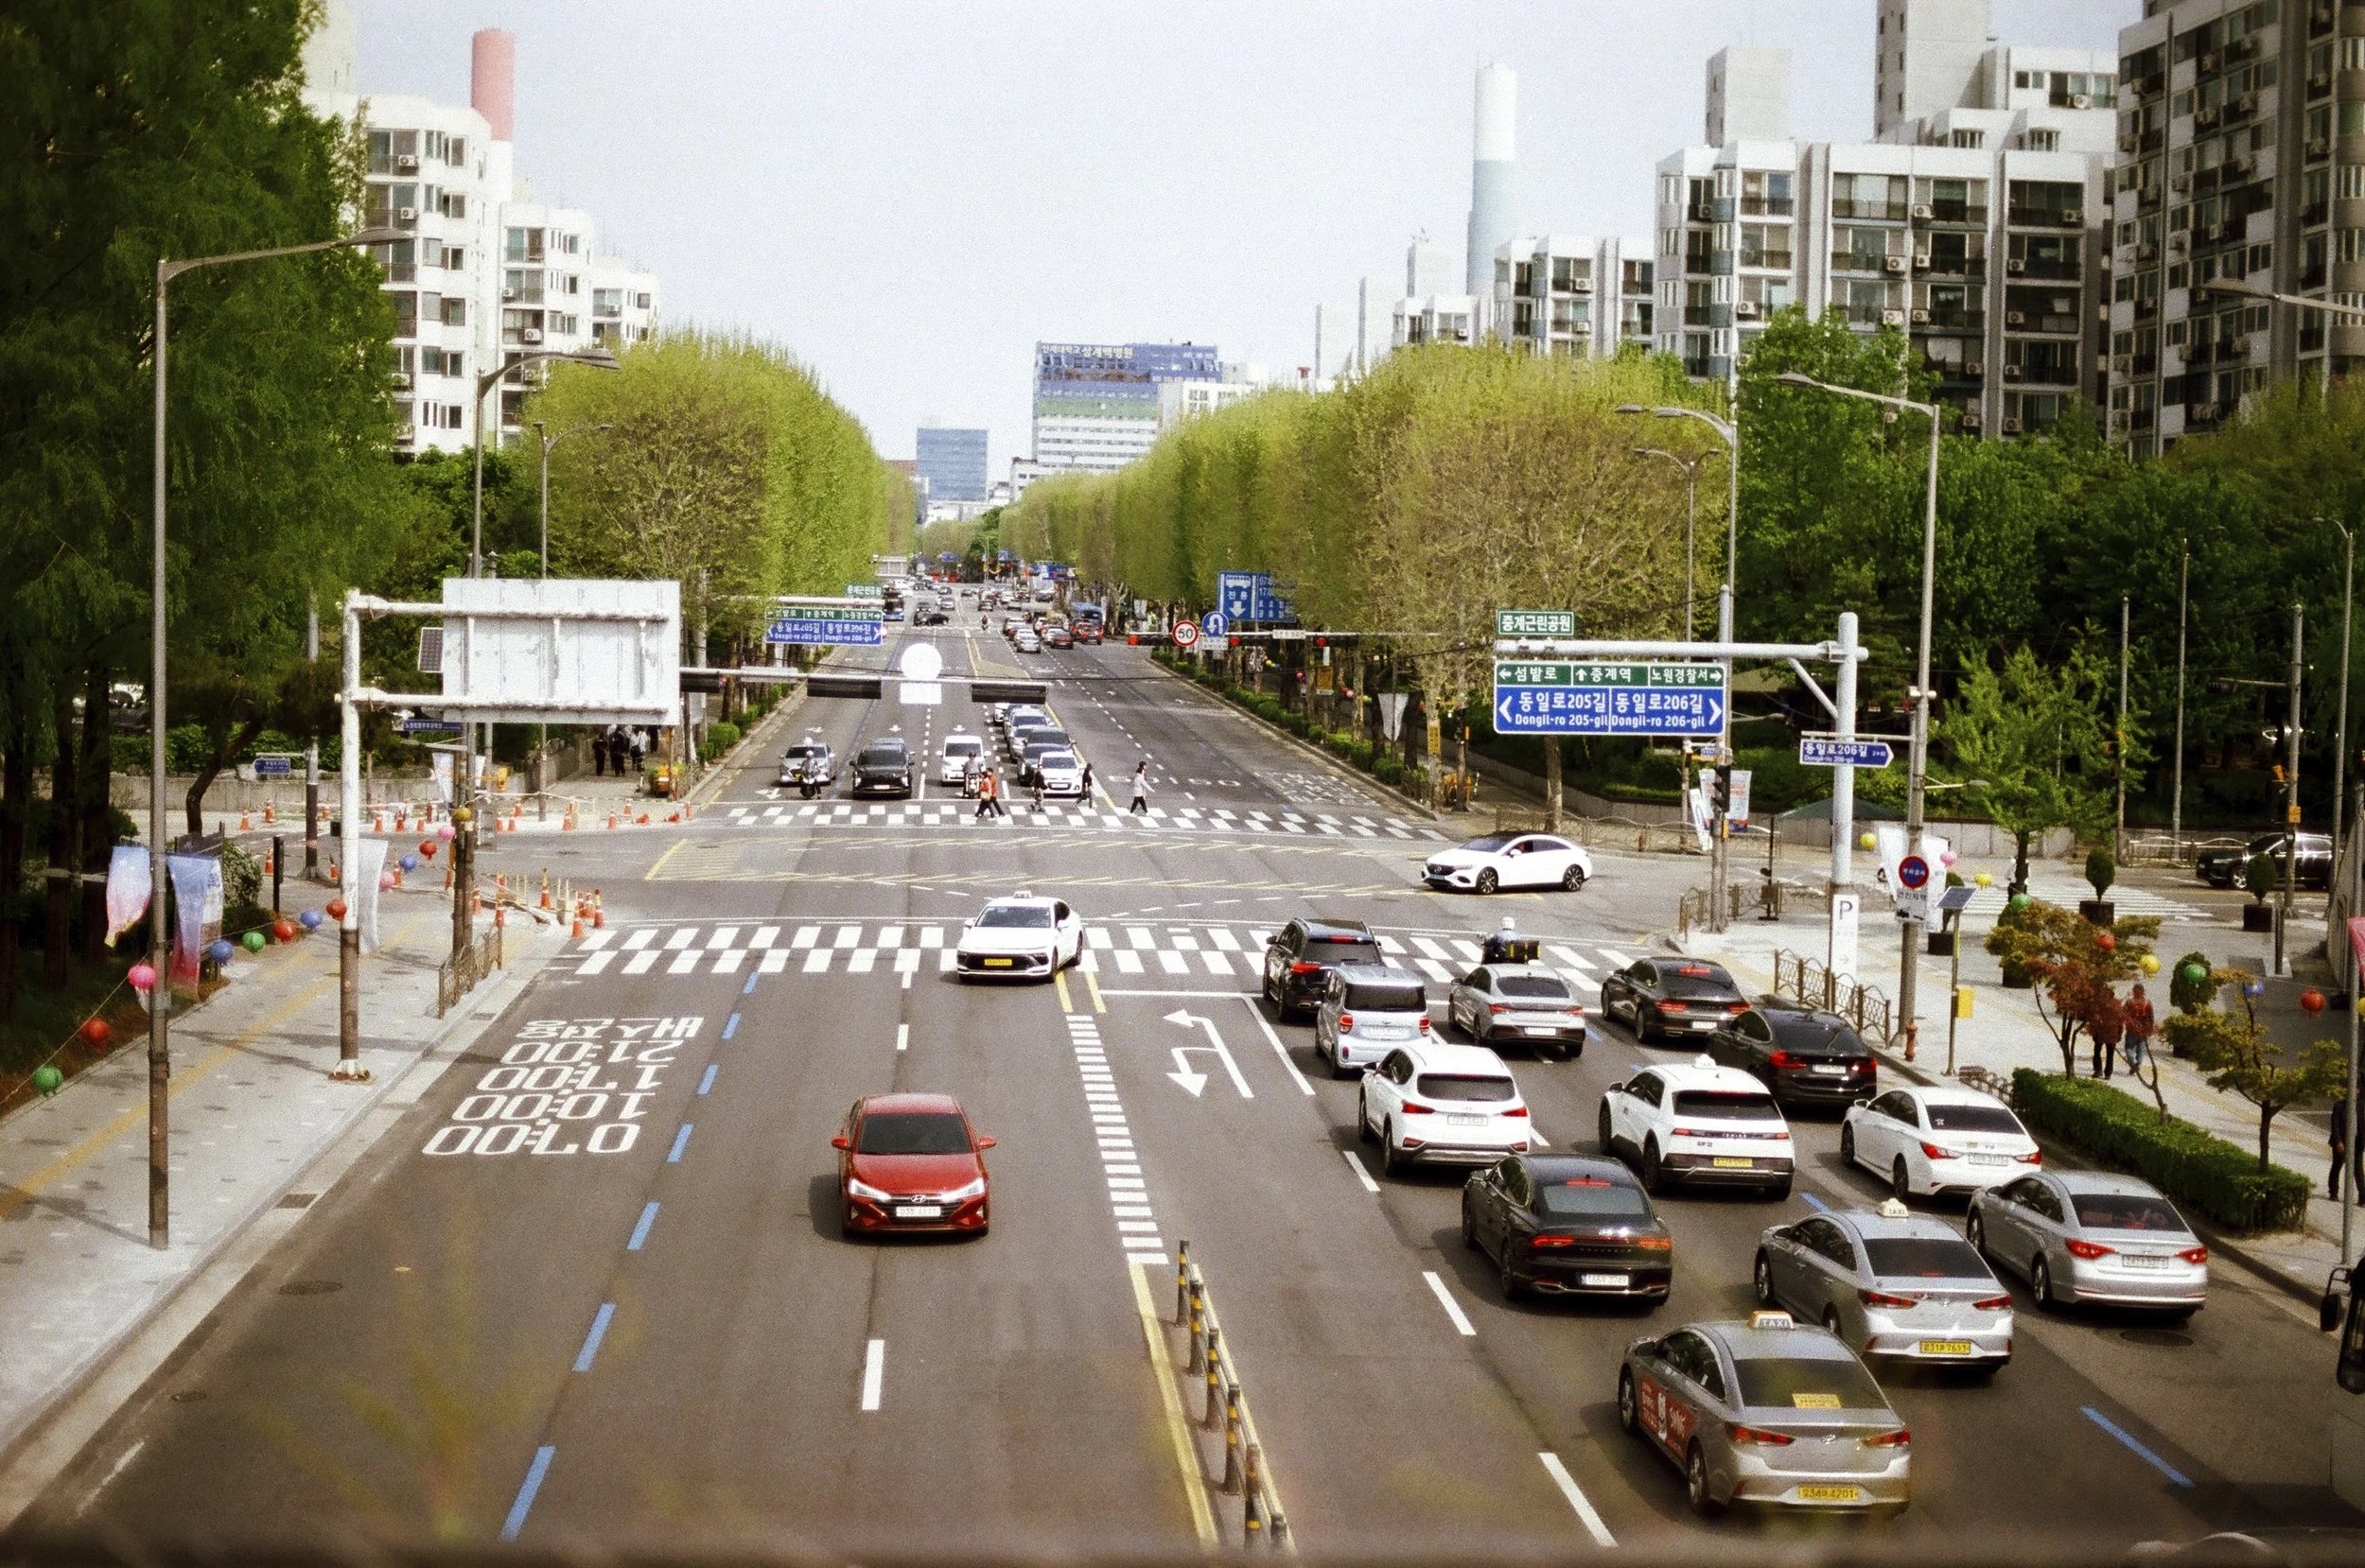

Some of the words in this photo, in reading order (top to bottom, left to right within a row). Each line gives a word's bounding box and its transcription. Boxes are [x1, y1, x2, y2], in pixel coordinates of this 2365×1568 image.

[1501, 614, 1570, 633] 중계근린공원
[1178, 628, 1194, 638] 50
[1590, 667, 1631, 683] 중계역
[1651, 668, 1708, 684] 노원경찰서
[1518, 691, 1605, 713] 동일로205길
[1615, 692, 1703, 714] 동일로206길
[1515, 714, 1566, 727] Dongil-ro
[1568, 715, 1608, 728] 205-gil
[1612, 715, 1662, 728] Dongil-ro
[1665, 716, 1705, 729] 206-gil
[1805, 742, 1867, 758] 동일로206길
[1839, 900, 1853, 920] P
[1761, 1319, 1788, 1328] TAXI
